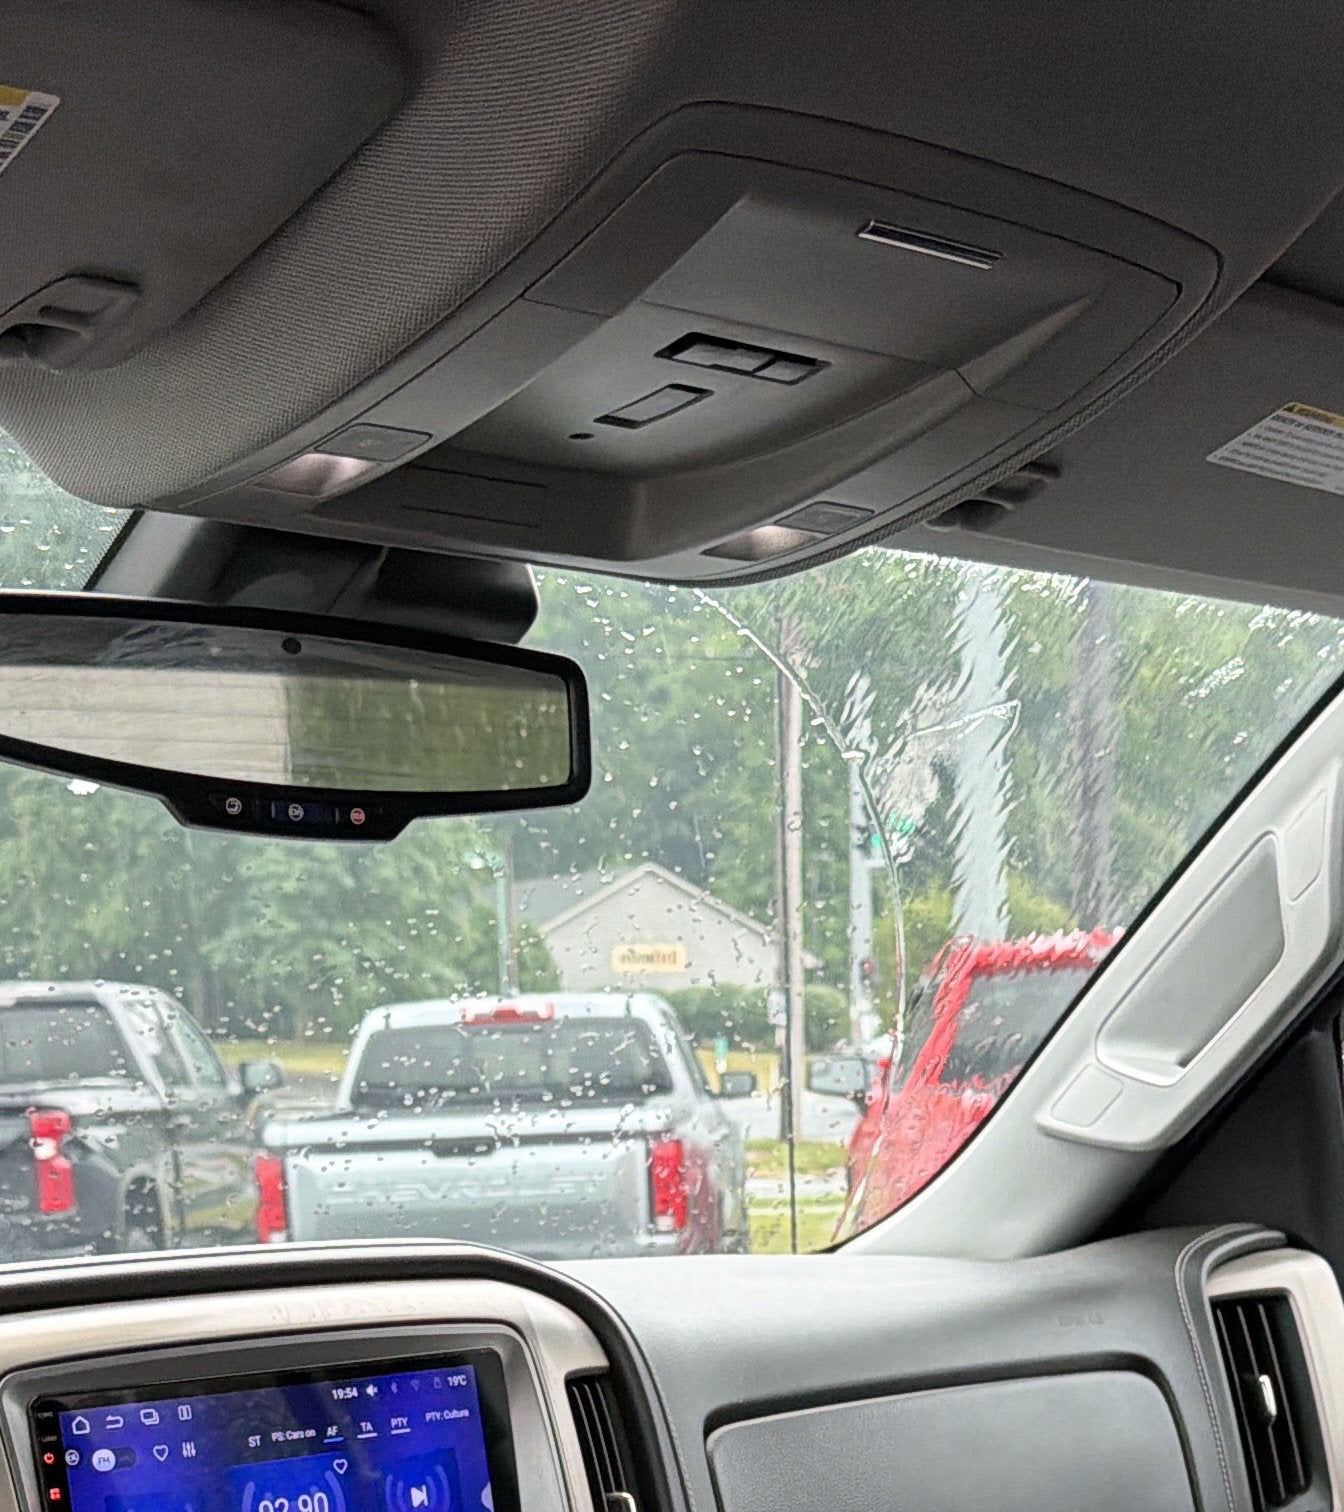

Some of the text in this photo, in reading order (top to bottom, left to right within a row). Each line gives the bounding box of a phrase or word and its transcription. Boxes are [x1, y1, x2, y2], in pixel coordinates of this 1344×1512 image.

[332, 1386, 358, 1400] 19:54
[360, 1421, 374, 1432] TA
[391, 1416, 409, 1429] PTY
[326, 1426, 339, 1437] AF
[248, 1435, 261, 1448] ST
[97, 1456, 111, 1466] FM
